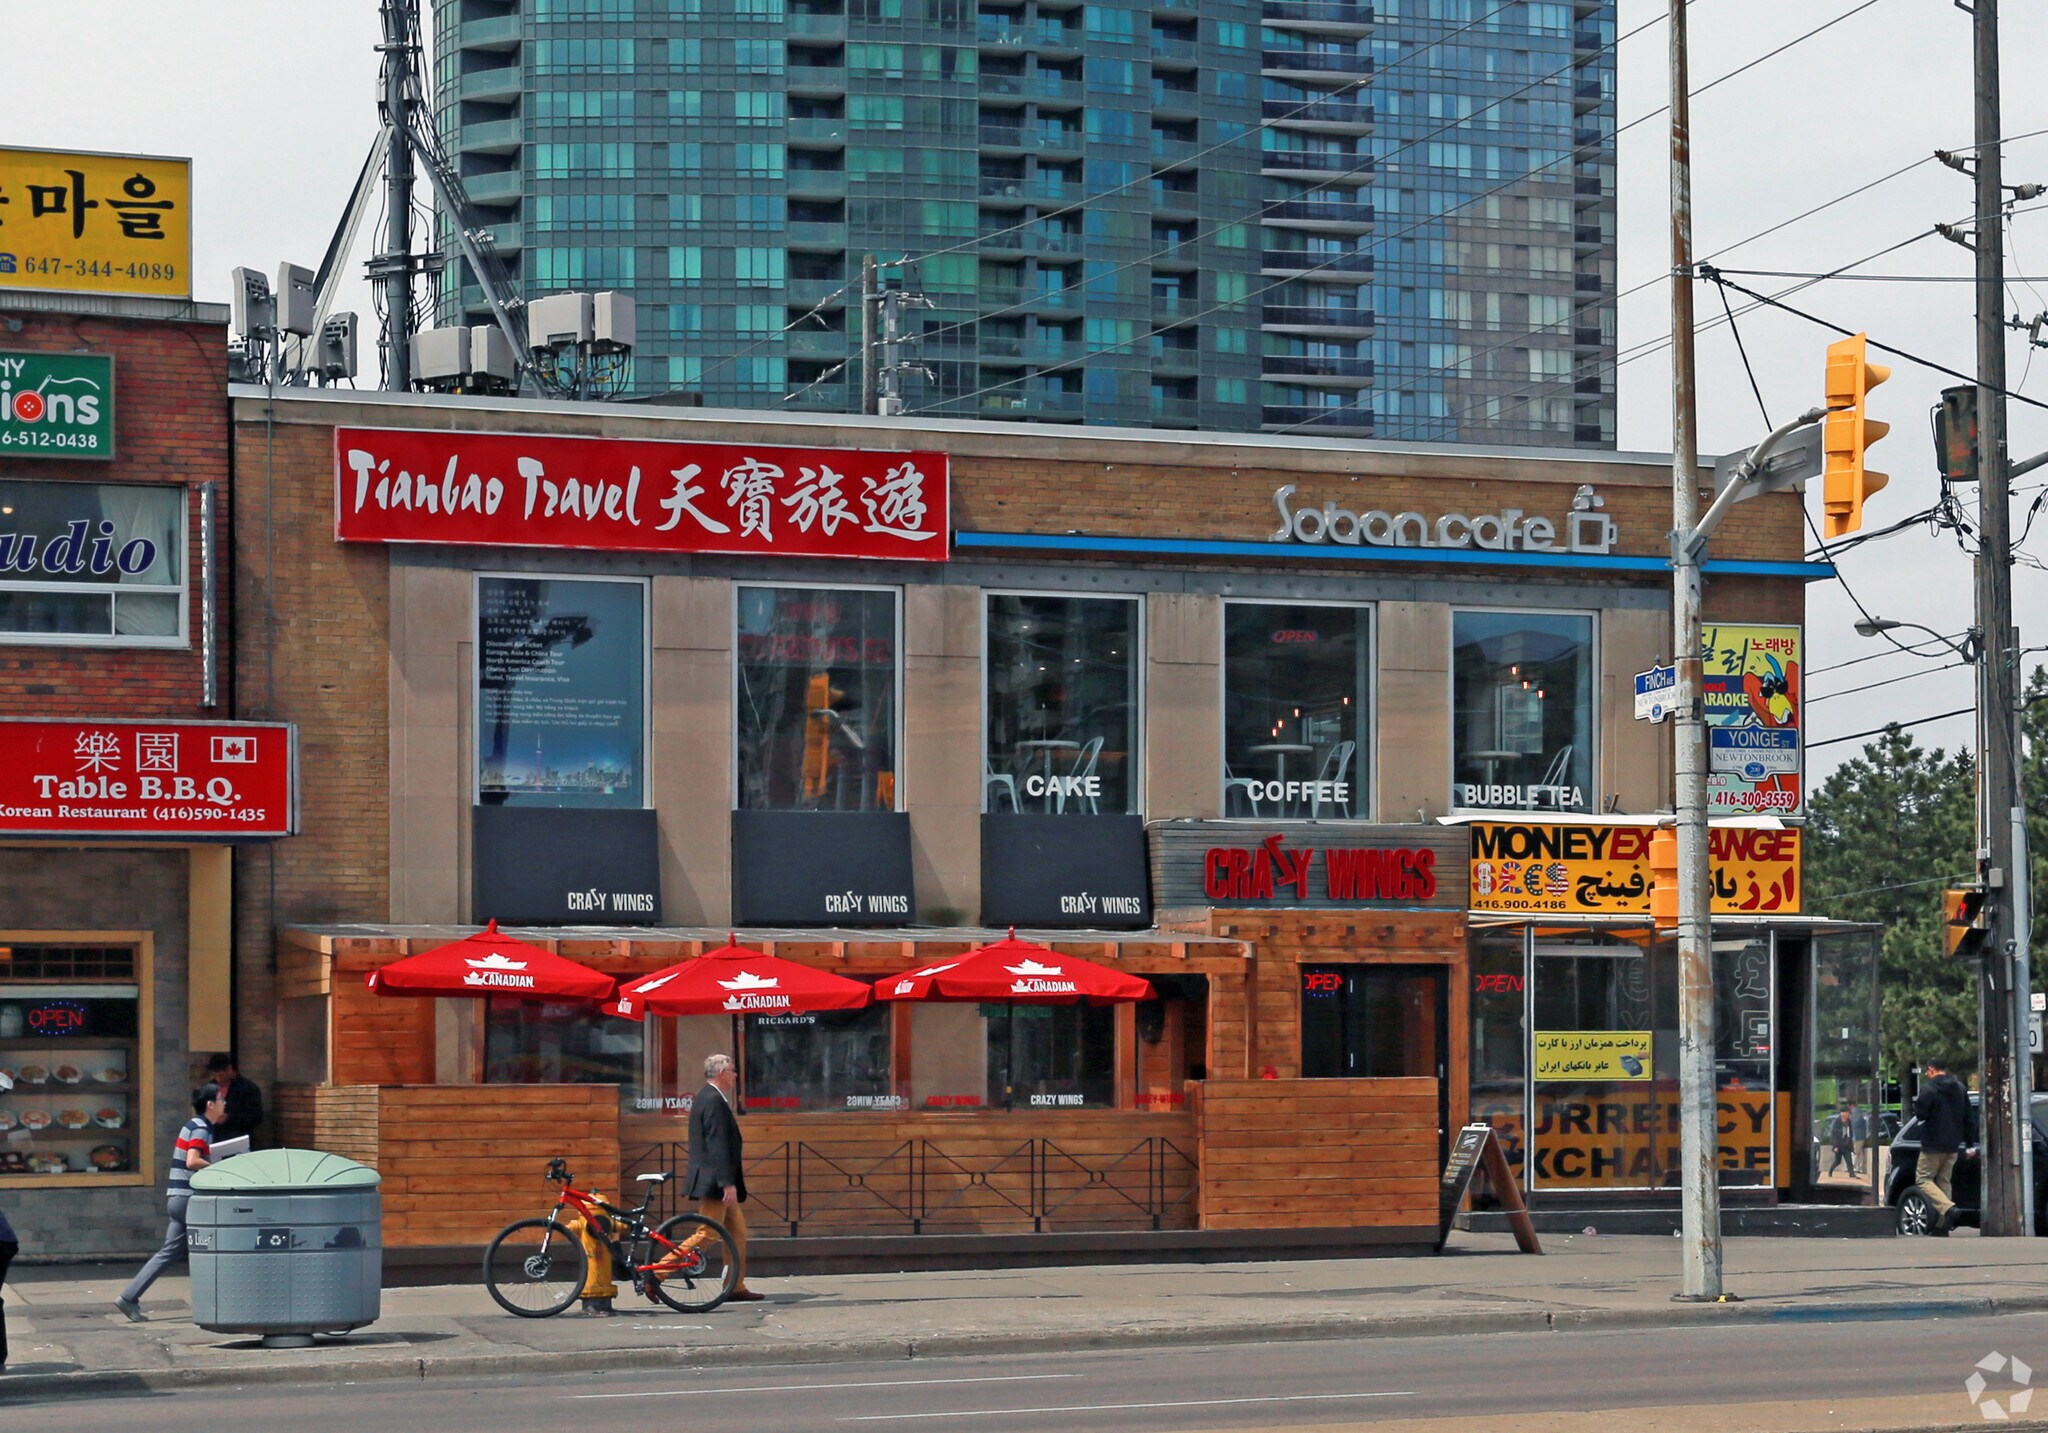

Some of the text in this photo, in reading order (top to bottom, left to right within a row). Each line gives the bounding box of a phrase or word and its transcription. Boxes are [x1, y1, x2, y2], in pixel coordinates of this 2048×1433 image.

[0, 170, 174, 240] 마을
[25, 256, 174, 281] 647-344-4089
[2, 430, 98, 448] 6-512-0438
[347, 449, 938, 542] Tianbao Travel 天寶旅遊
[1268, 484, 1556, 550] Soban cafe
[1750, 638, 1795, 656] 노래방
[1645, 671, 1666, 691] FINCH
[1728, 731, 1780, 747] YONGE
[1715, 753, 1793, 762] NEWTONBROOK
[33, 775, 242, 806] Table B.B.Q.
[1026, 775, 1101, 797] CAKE
[1247, 780, 1350, 802] COFFEE
[1464, 785, 1584, 806] BUBBLE TEA
[1715, 791, 1794, 806] 416-300-3559
[58, 805, 147, 819] Restaurant
[153, 806, 266, 822] (416)590-1435
[1609, 827, 1797, 862] EXANGE
[1205, 833, 1437, 900] CRAZY WINGS
[568, 888, 654, 912] CRAZY WINGS
[825, 890, 908, 914] CRAZY WINGS
[1061, 892, 1141, 914] CRAZY WINGS
[1474, 900, 1566, 909] 416.900.4186
[482, 973, 534, 988] CANADIAN
[1027, 980, 1077, 992] CANADIAN
[740, 995, 791, 1009] CANADIAN
[28, 1009, 83, 1027] OPEN
[758, 1016, 815, 1025] RICKARD'S
[1538, 1061, 1561, 1073] ایران
[1031, 1094, 1084, 1106] CRAZY WINGS
